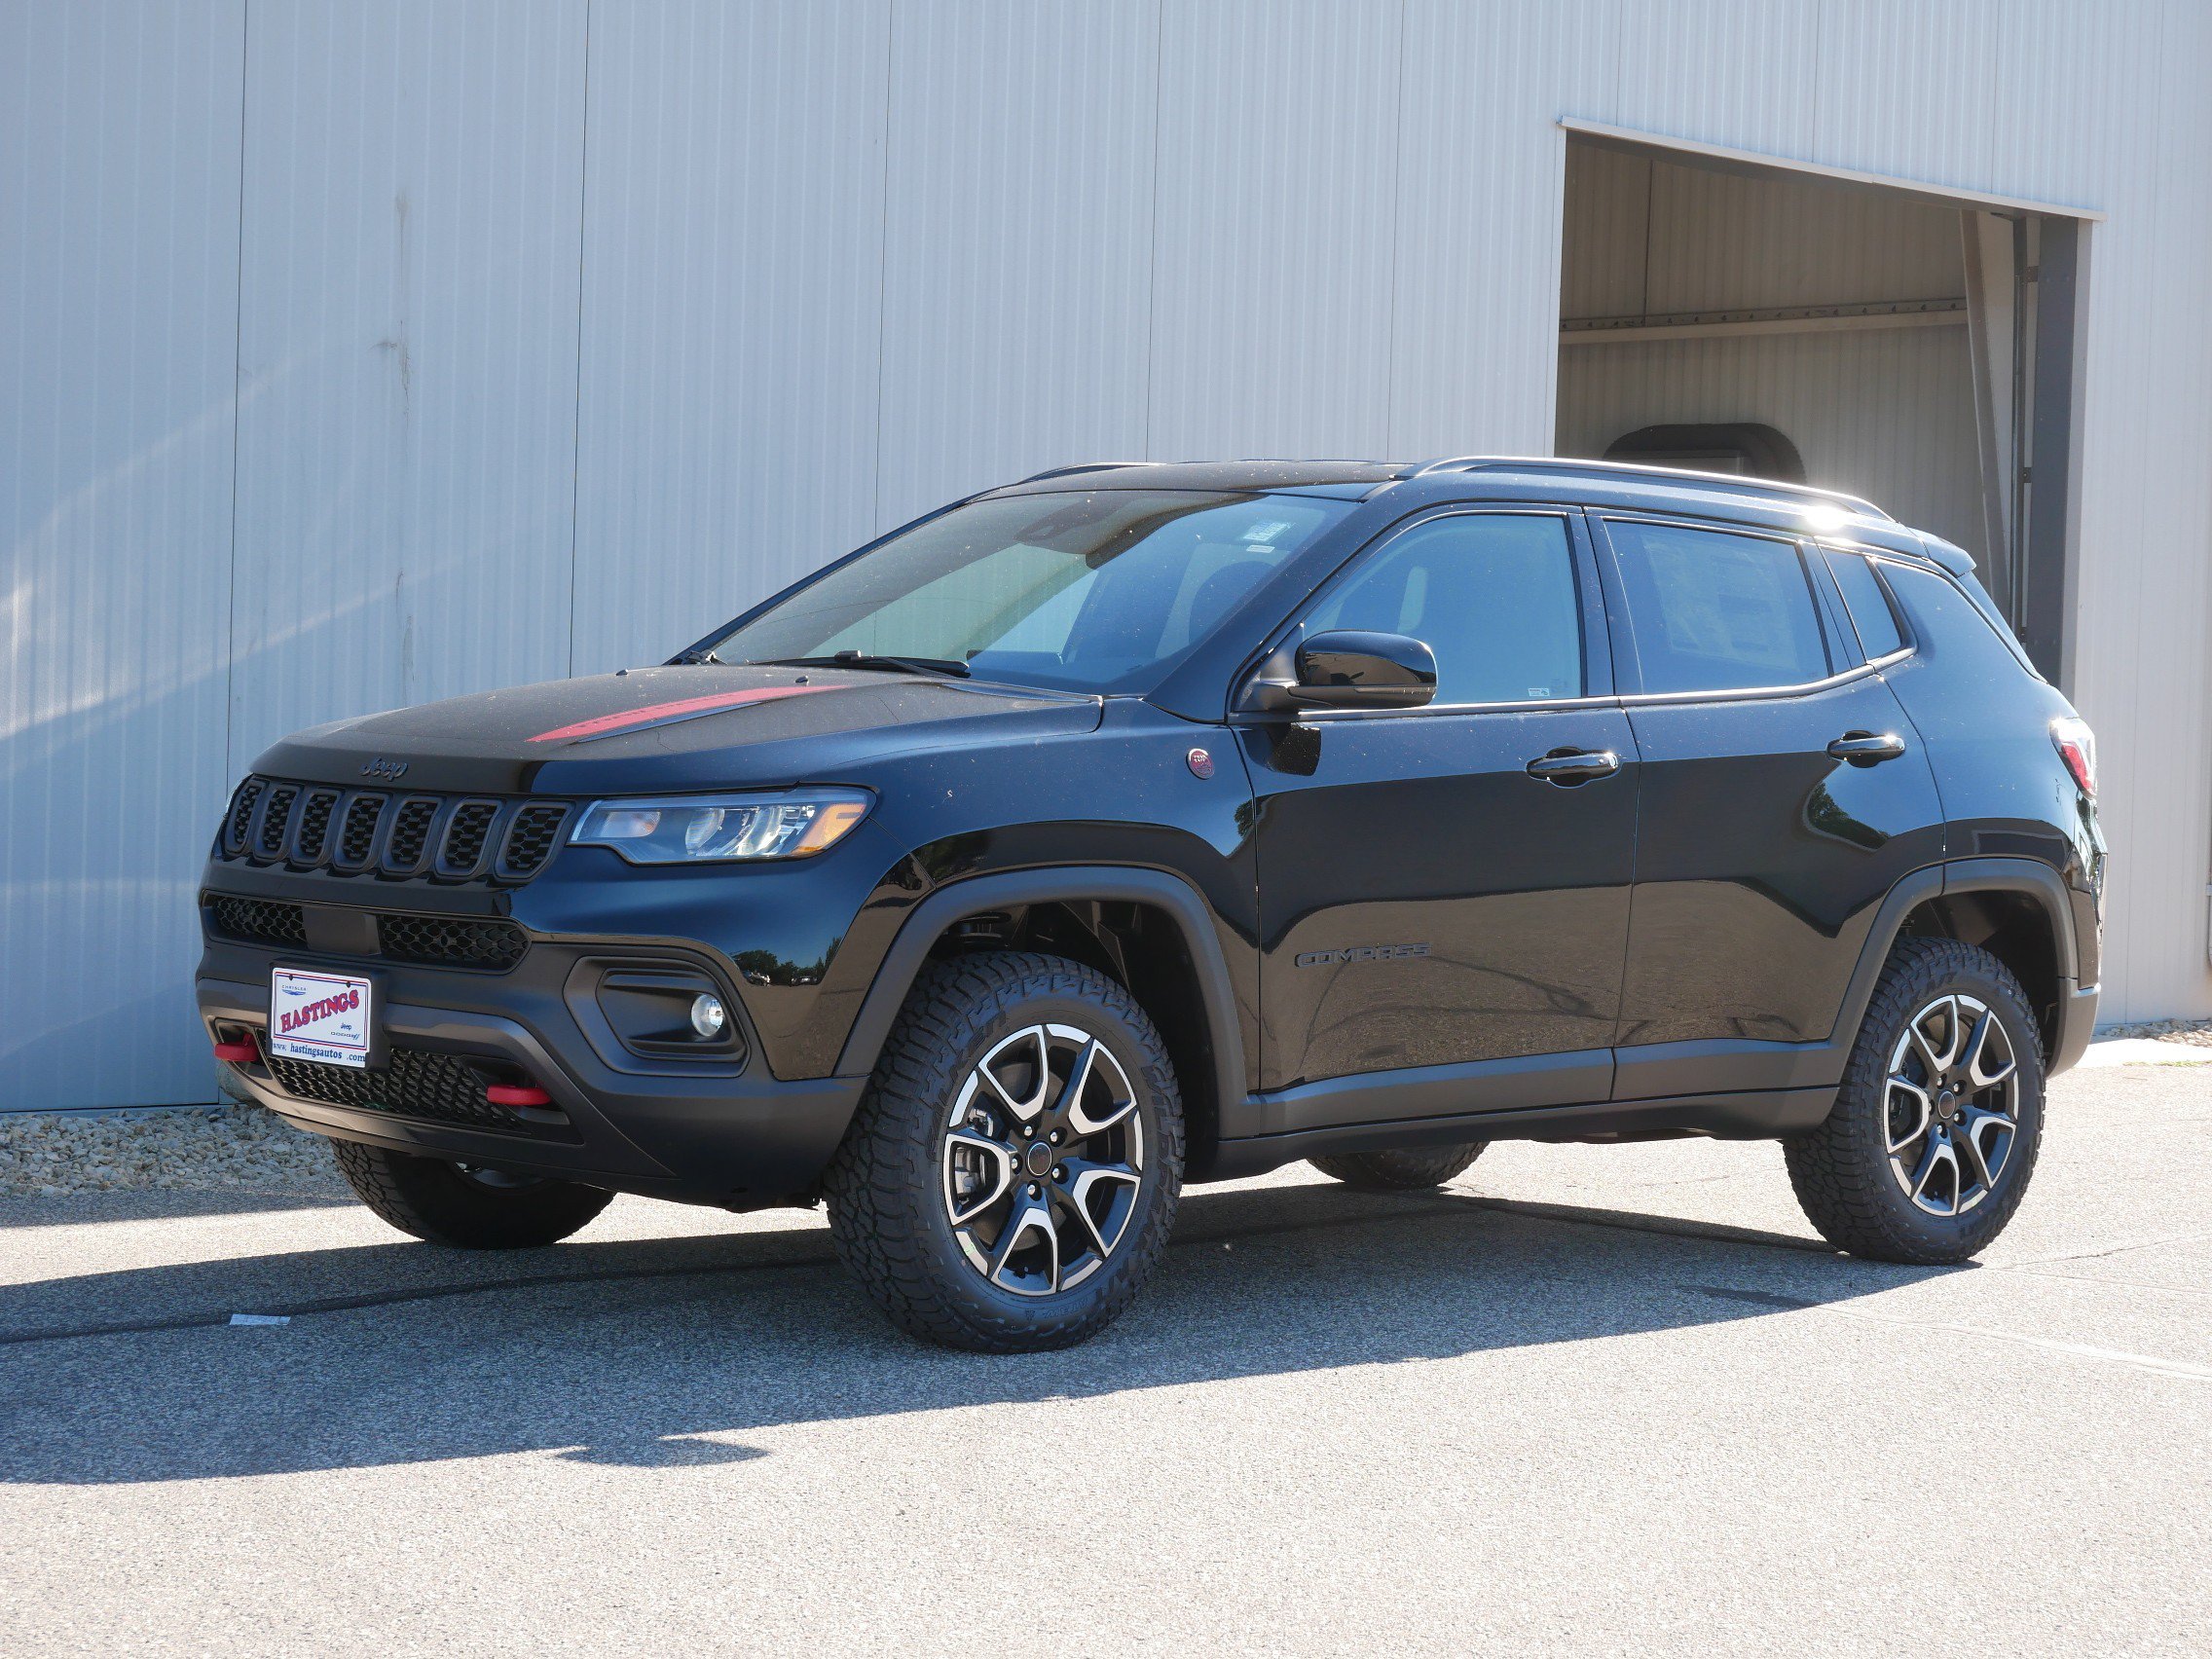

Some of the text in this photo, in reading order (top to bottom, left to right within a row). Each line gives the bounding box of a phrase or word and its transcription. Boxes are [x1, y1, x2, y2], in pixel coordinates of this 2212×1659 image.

[359, 757, 408, 782] Jeep
[1294, 942, 1432, 968] COMPASS
[280, 989, 359, 1033] HASTINGS
[290, 1043, 343, 1058] hastingsautos
